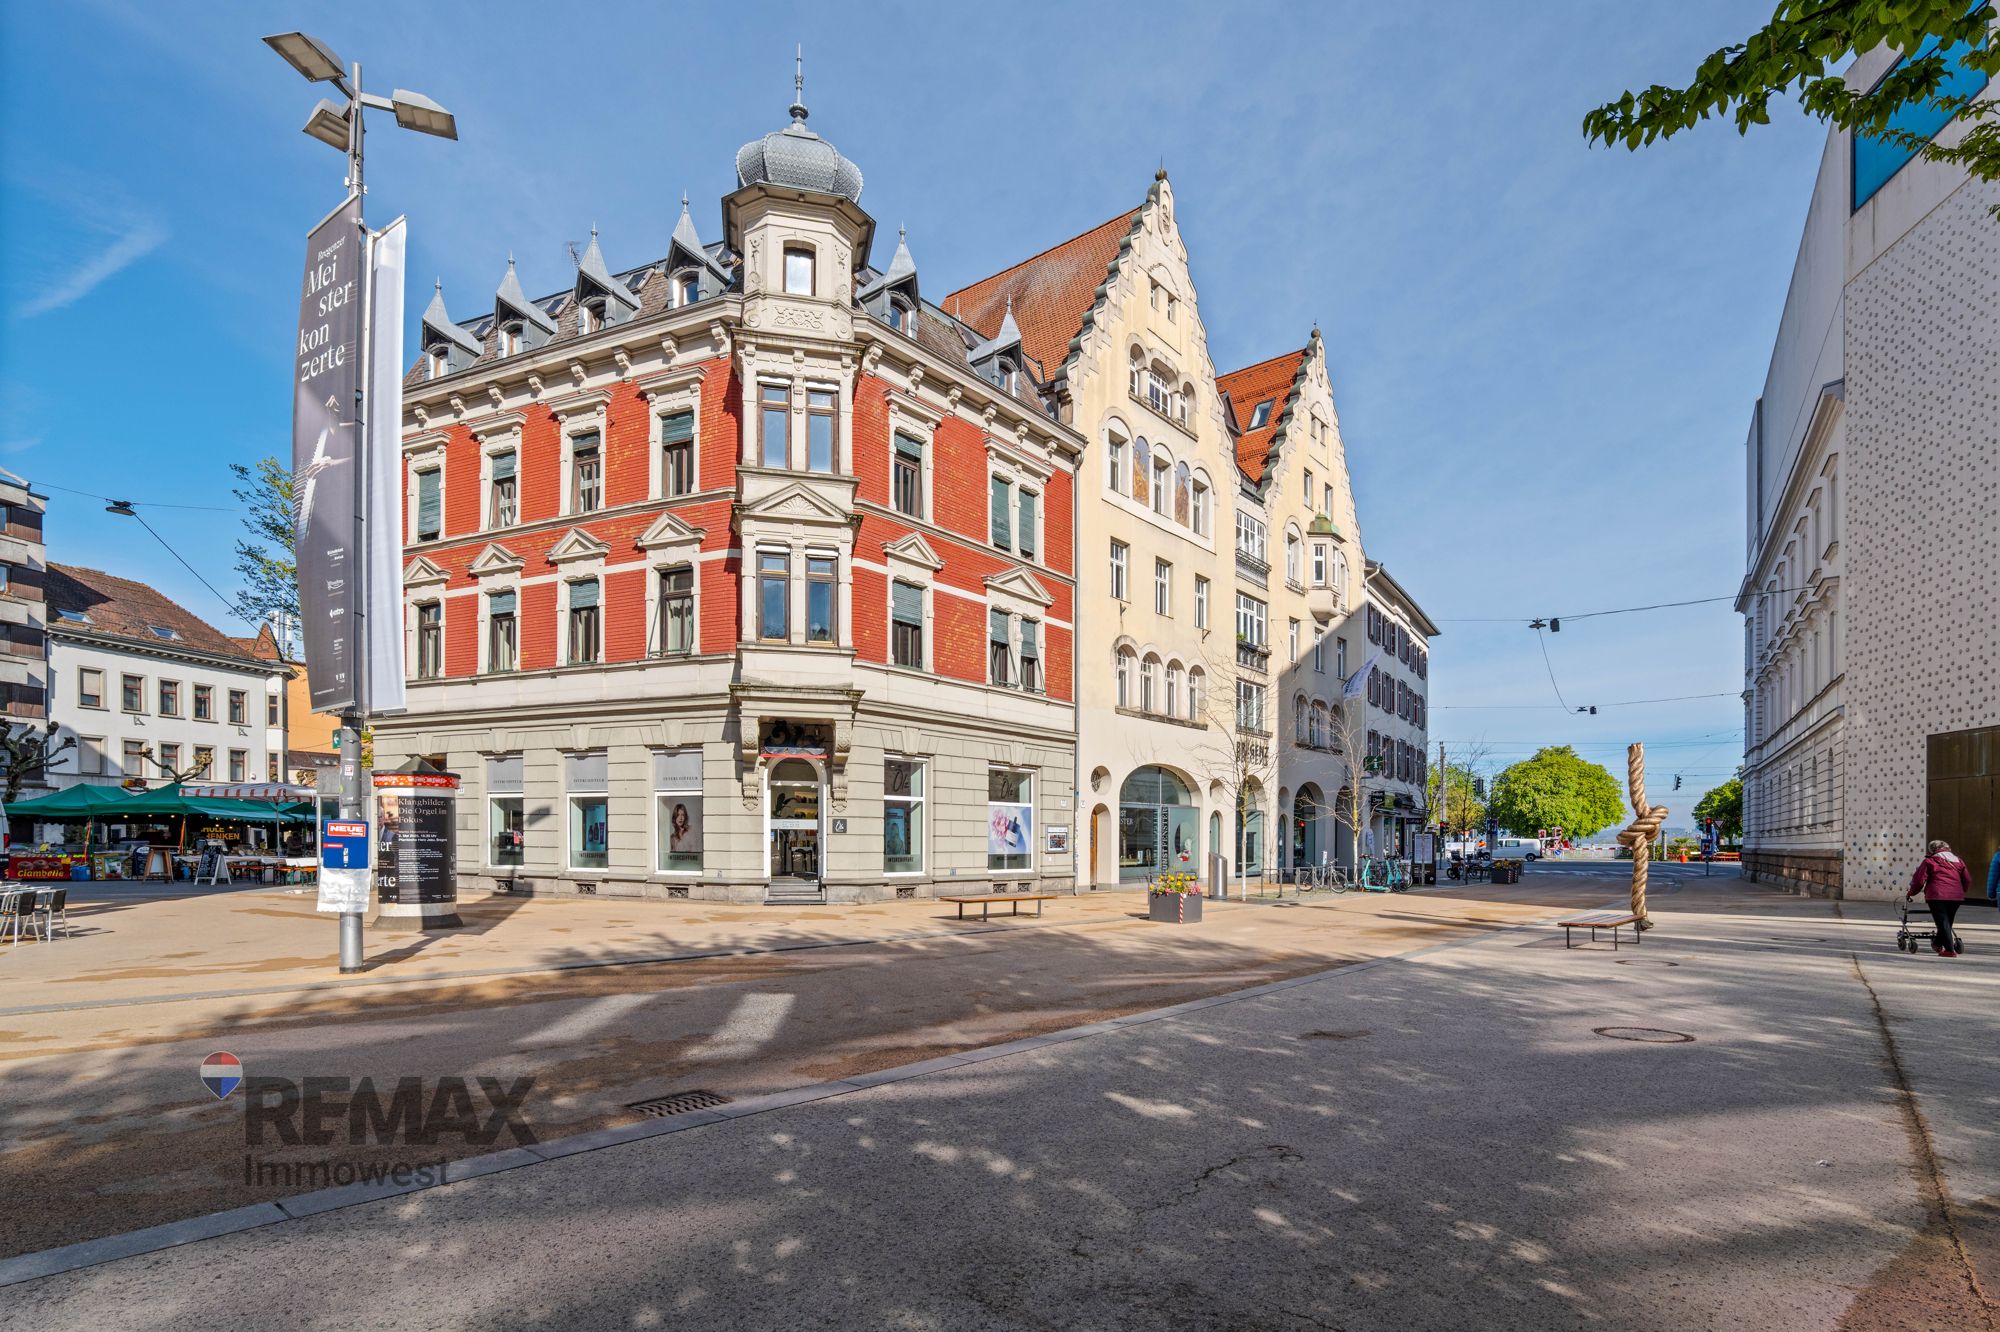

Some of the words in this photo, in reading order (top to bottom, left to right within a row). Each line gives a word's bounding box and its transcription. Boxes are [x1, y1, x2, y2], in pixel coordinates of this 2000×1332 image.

[306, 254, 337, 298] Mei
[318, 281, 353, 317] ster
[299, 323, 329, 356] kon
[301, 344, 345, 383] zerte
[398, 798, 446, 807] Klangbilder.
[398, 807, 413, 815] Die
[414, 807, 437, 816] Orgel
[329, 825, 364, 833] NEUE
[398, 816, 424, 824] Fokus
